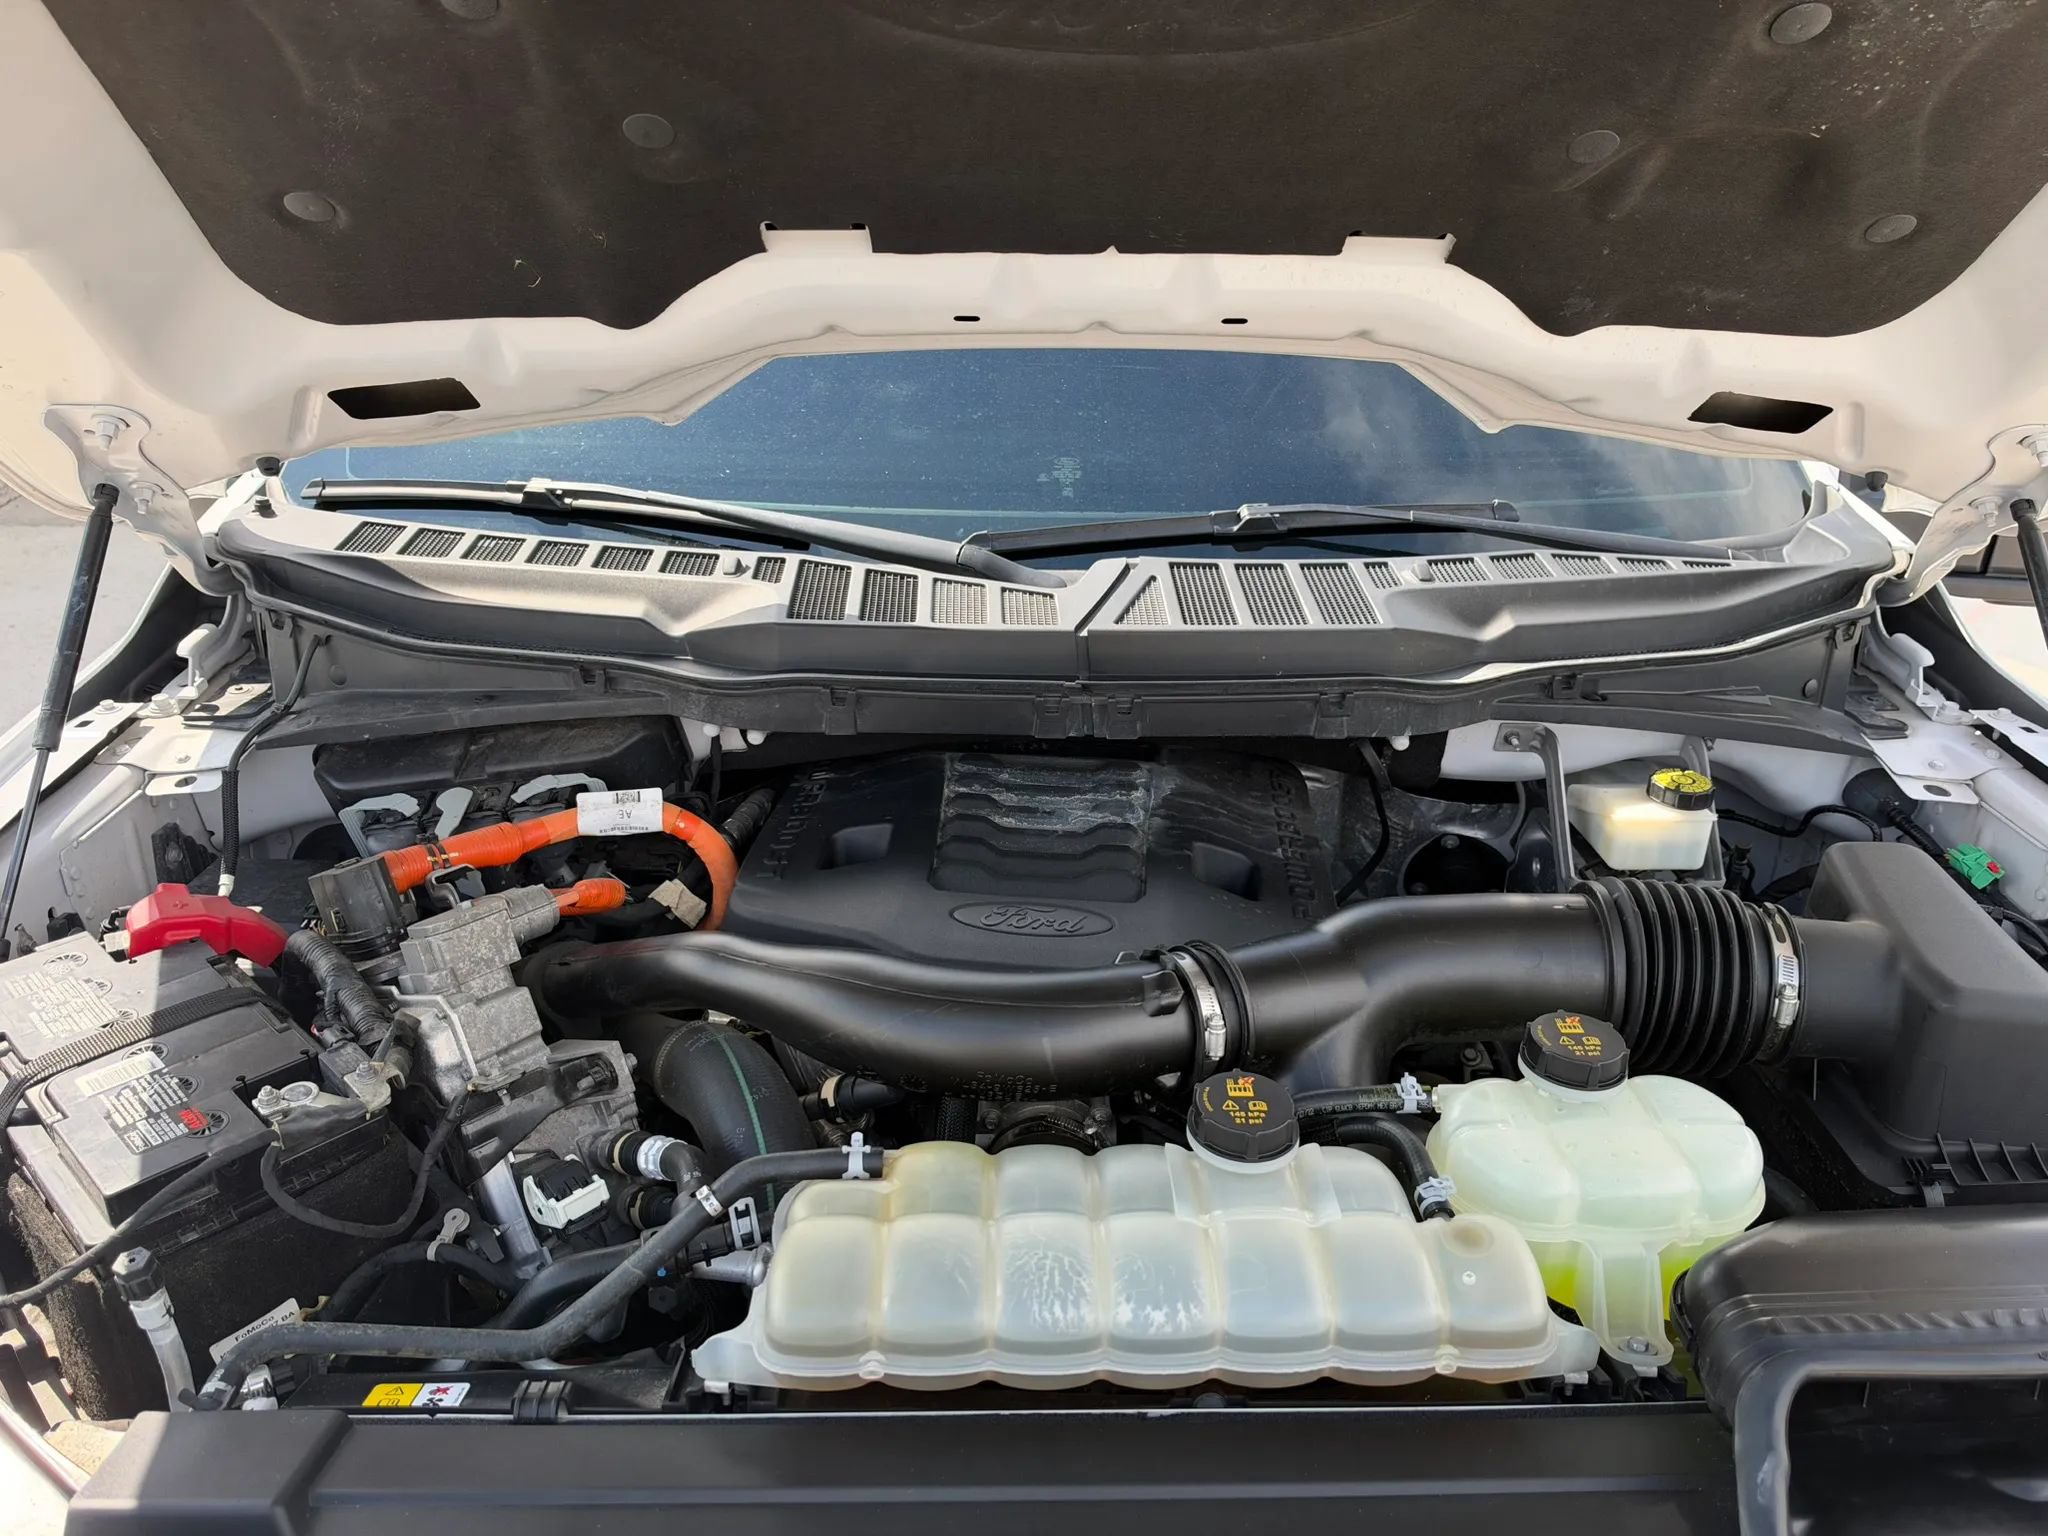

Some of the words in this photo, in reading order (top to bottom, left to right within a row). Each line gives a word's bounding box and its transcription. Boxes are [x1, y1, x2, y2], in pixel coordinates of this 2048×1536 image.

[980, 904, 1088, 933] Ford
[234, 1315, 275, 1342] FoMoCo
[281, 1311, 295, 1322] BA
